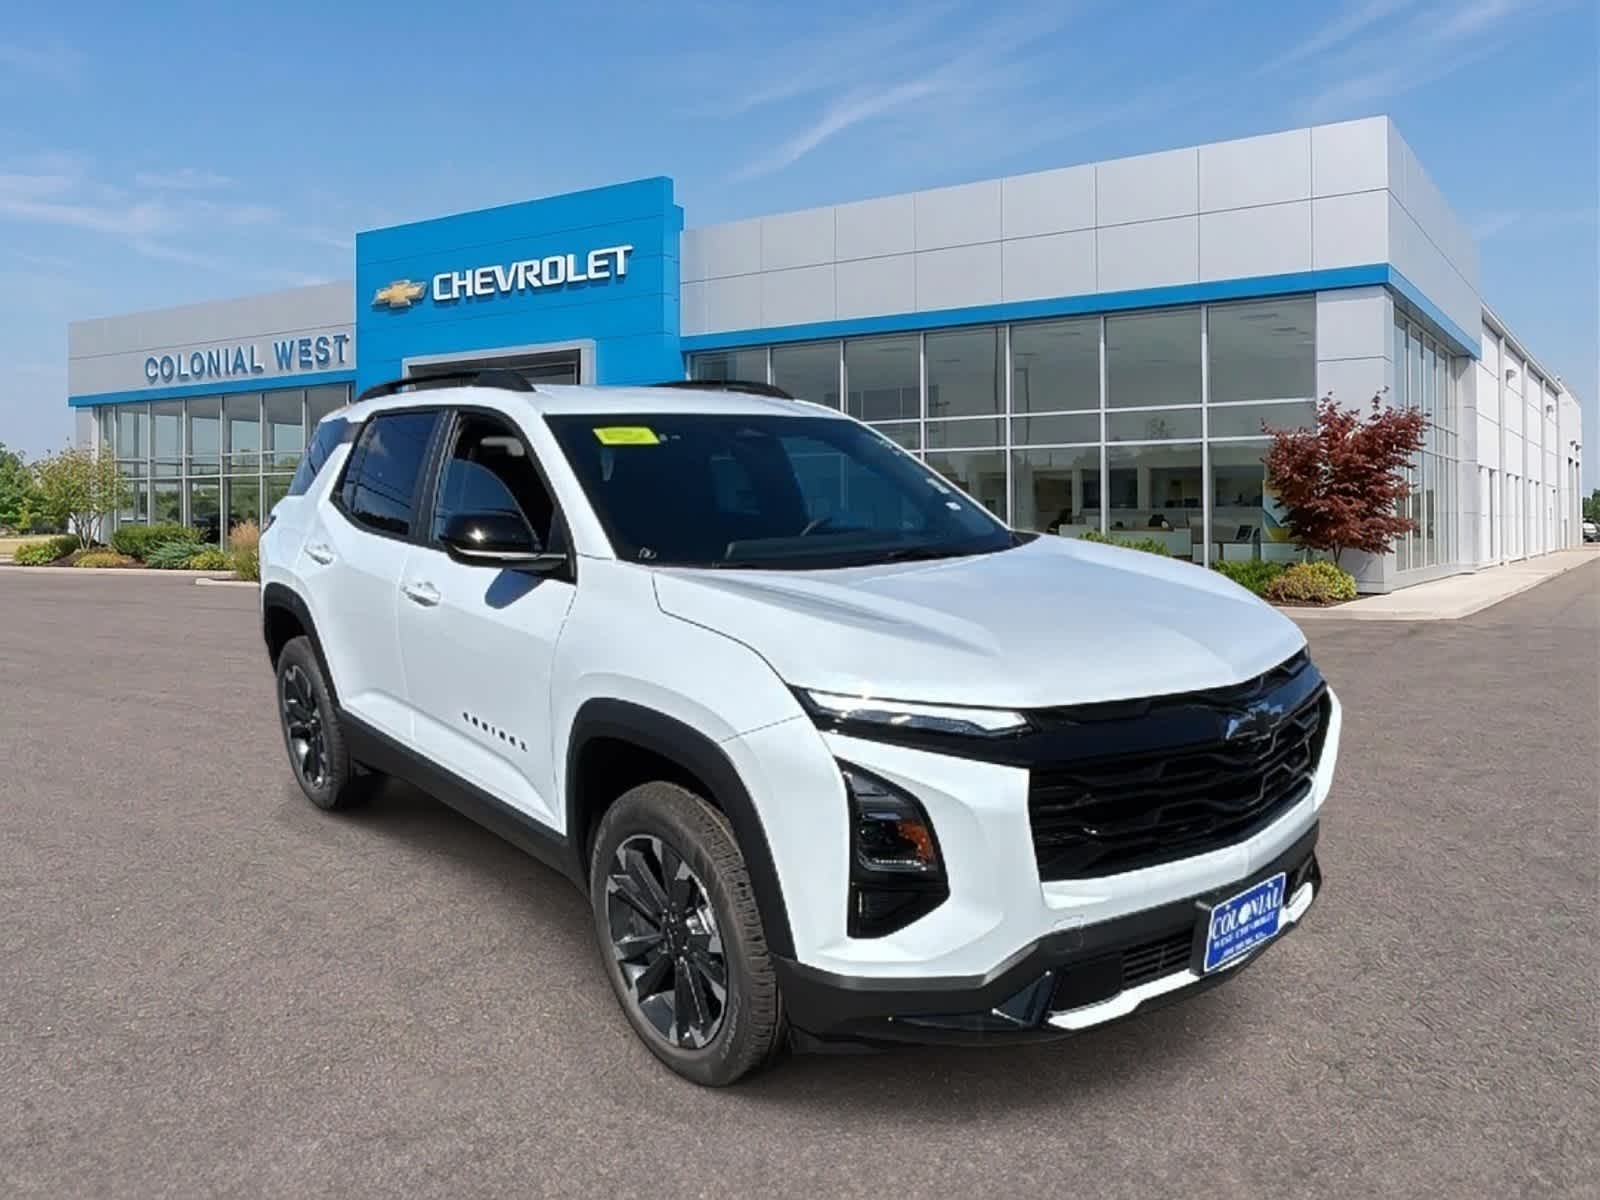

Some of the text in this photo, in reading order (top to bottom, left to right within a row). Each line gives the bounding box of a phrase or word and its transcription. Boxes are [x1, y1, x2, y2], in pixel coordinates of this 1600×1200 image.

[433, 245, 633, 301] CHEVROLET
[145, 334, 350, 384] COLONIAL WEST
